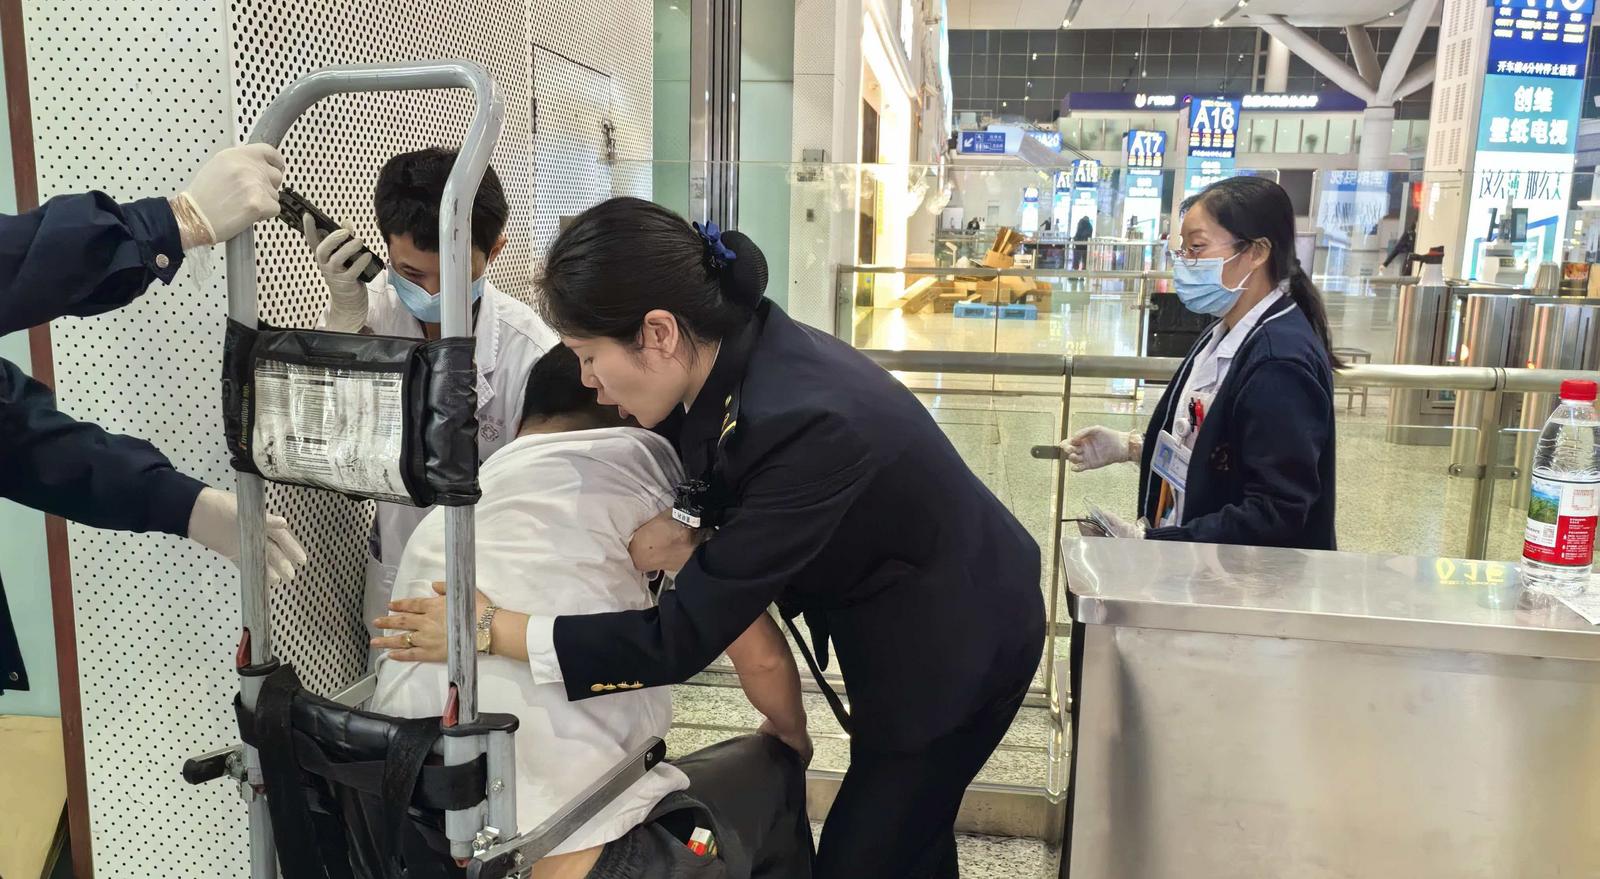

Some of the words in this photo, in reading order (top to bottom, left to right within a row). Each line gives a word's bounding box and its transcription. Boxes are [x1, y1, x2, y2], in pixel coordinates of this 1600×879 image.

[1514, 85, 1553, 112] 创维
[1193, 106, 1234, 130] A16
[1489, 116, 1568, 145] 壁纸电视
[1130, 132, 1163, 155] A17
